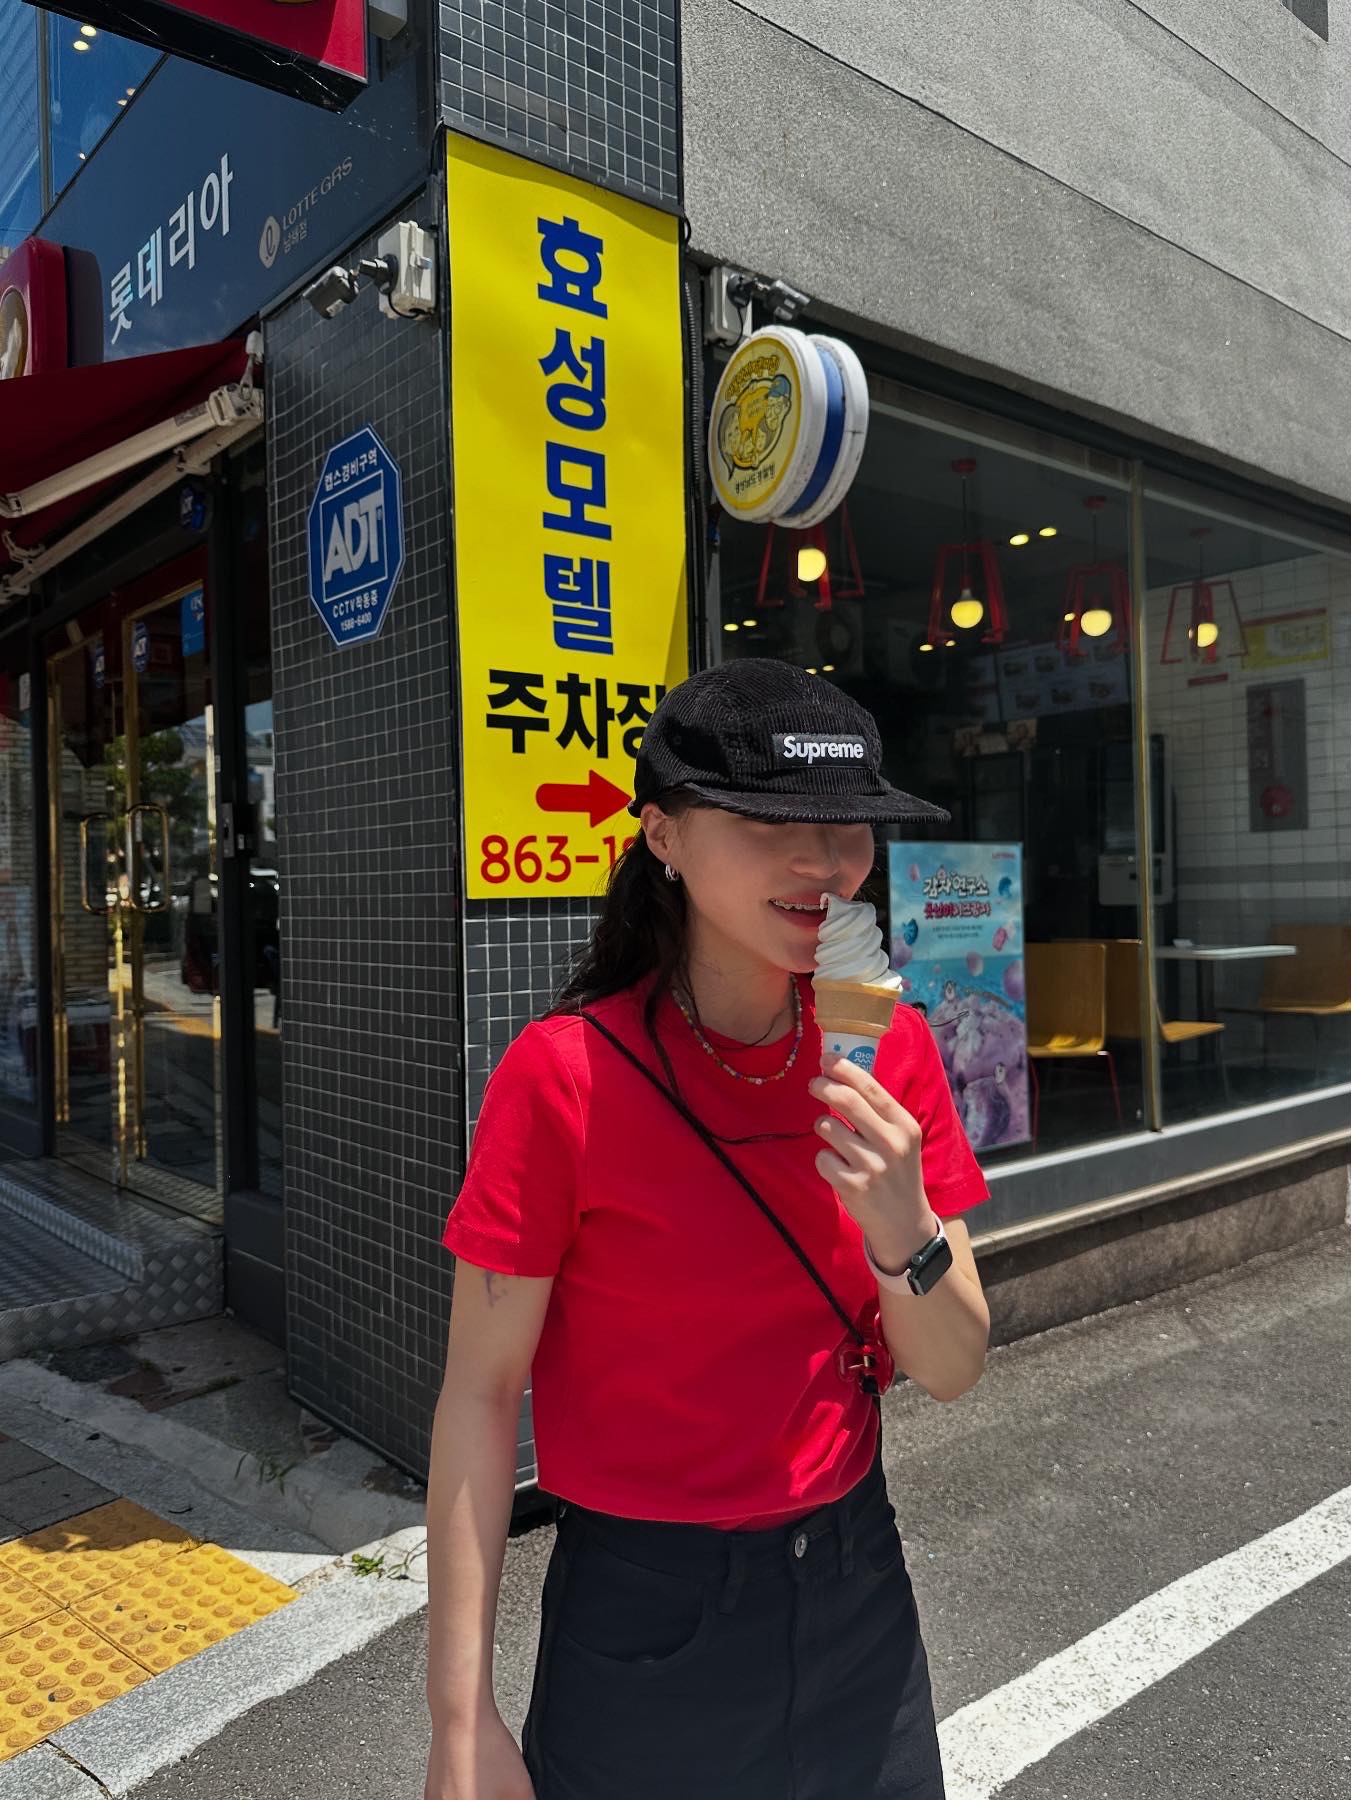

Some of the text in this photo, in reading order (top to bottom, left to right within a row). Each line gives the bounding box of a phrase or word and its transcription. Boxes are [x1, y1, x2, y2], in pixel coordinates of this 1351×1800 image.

[282, 156, 353, 231] LOTTE GRS
[110, 152, 234, 345] 롯데리아
[536, 215, 614, 656] 효성모텔
[323, 488, 384, 584] ADT
[486, 668, 666, 759] 주차장
[783, 735, 864, 764] Supreme
[480, 834, 636, 884] 863-1
